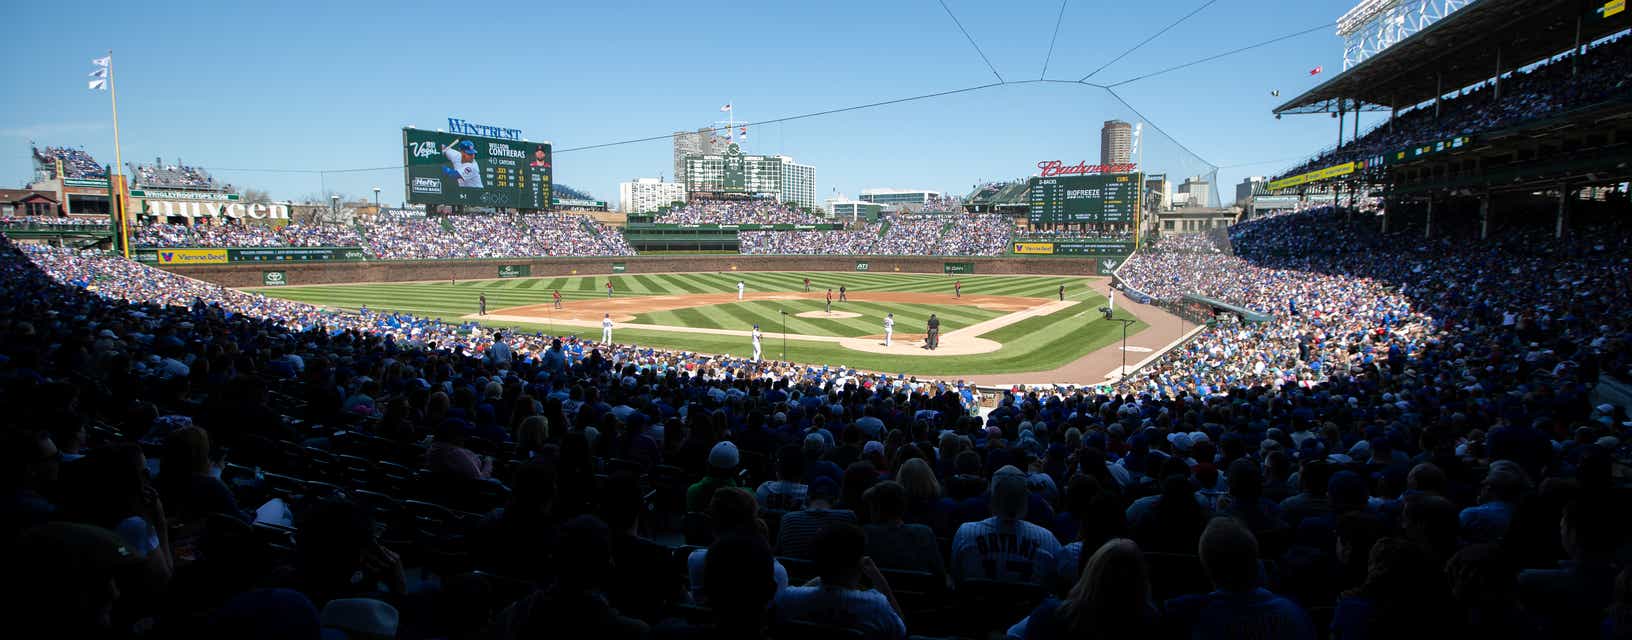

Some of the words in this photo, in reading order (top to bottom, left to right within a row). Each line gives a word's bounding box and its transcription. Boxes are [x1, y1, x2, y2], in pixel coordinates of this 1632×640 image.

[448, 118, 521, 140] WINTRUST
[488, 148, 526, 158] CONTRERAS
[1037, 160, 1136, 177] Budweiser
[975, 534, 1041, 556] BRYANT
